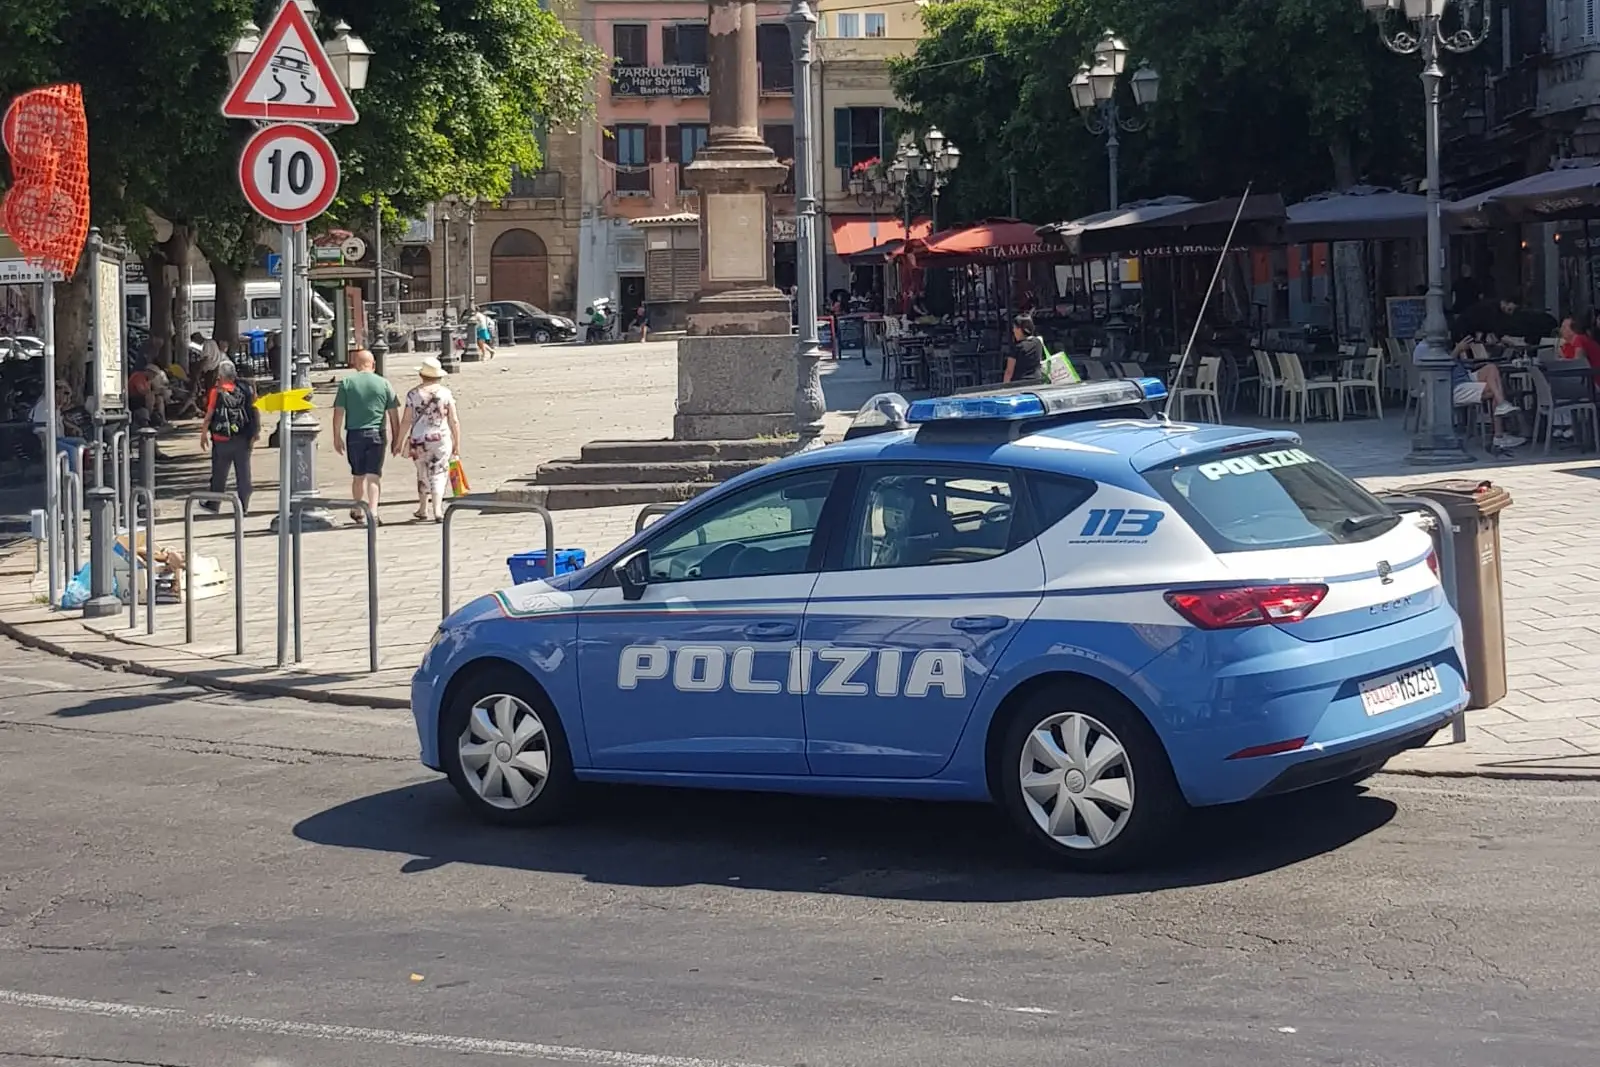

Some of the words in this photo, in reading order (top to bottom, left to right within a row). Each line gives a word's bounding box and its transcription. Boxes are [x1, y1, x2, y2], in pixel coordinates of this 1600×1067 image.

[617, 66, 708, 78] PARRUCCHIERI
[632, 77, 653, 86] Hair
[654, 76, 686, 88] Stylist
[640, 86, 670, 95] Barber
[671, 85, 695, 96] Shop
[268, 149, 313, 195] 10
[1198, 448, 1317, 481] POLIZIA
[1080, 508, 1165, 537] 113
[617, 645, 966, 697] POLIZIA
[1396, 666, 1438, 701] M3239
